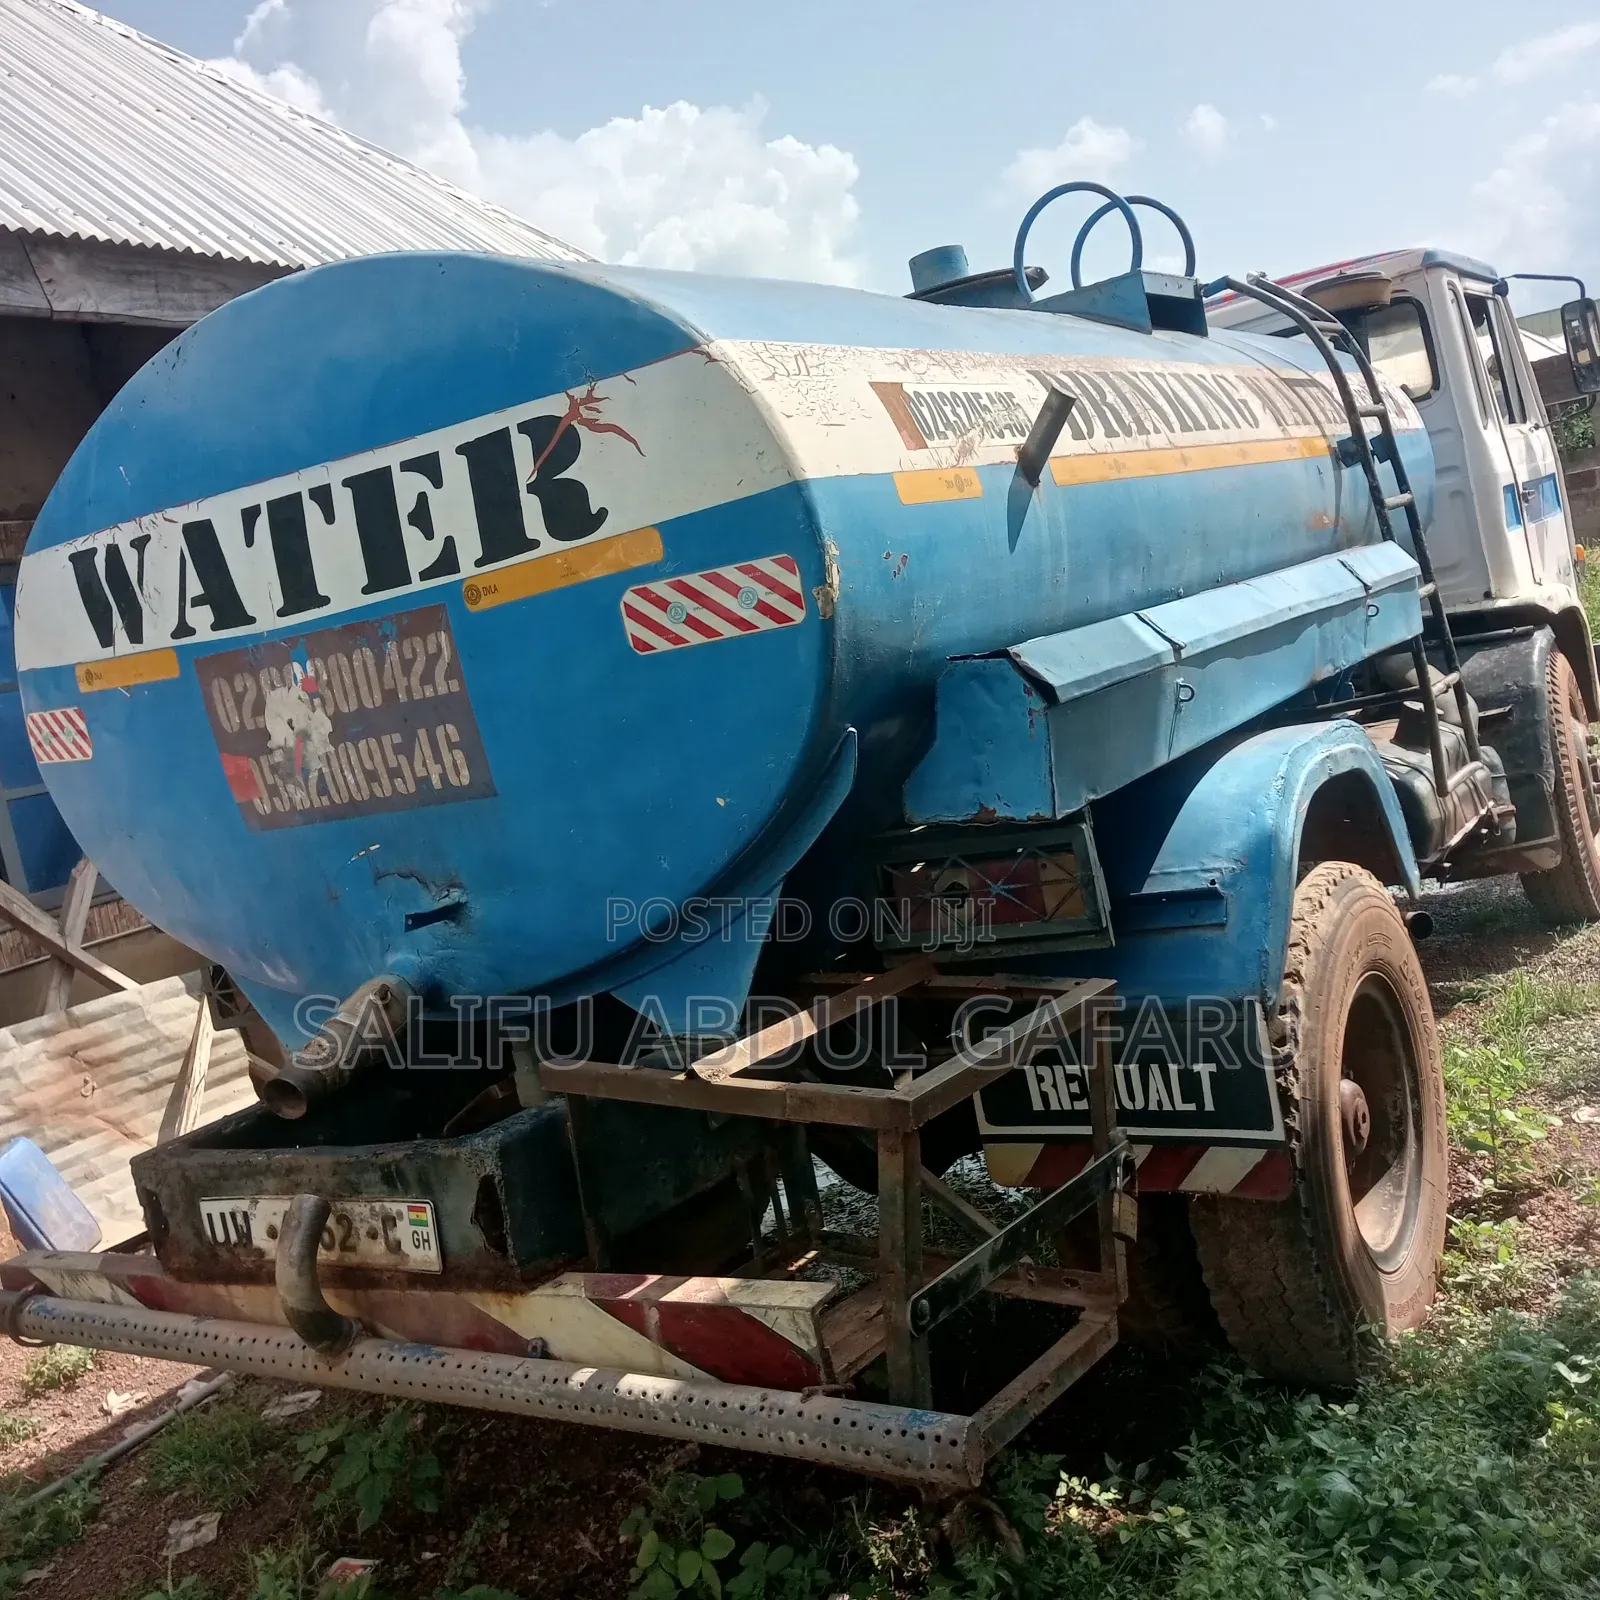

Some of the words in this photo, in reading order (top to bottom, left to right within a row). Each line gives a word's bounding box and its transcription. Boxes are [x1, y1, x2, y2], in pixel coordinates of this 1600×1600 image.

[1027, 369, 1259, 441] DRINKING
[68, 414, 609, 649] WATER
[411, 1230, 431, 1251] GH
